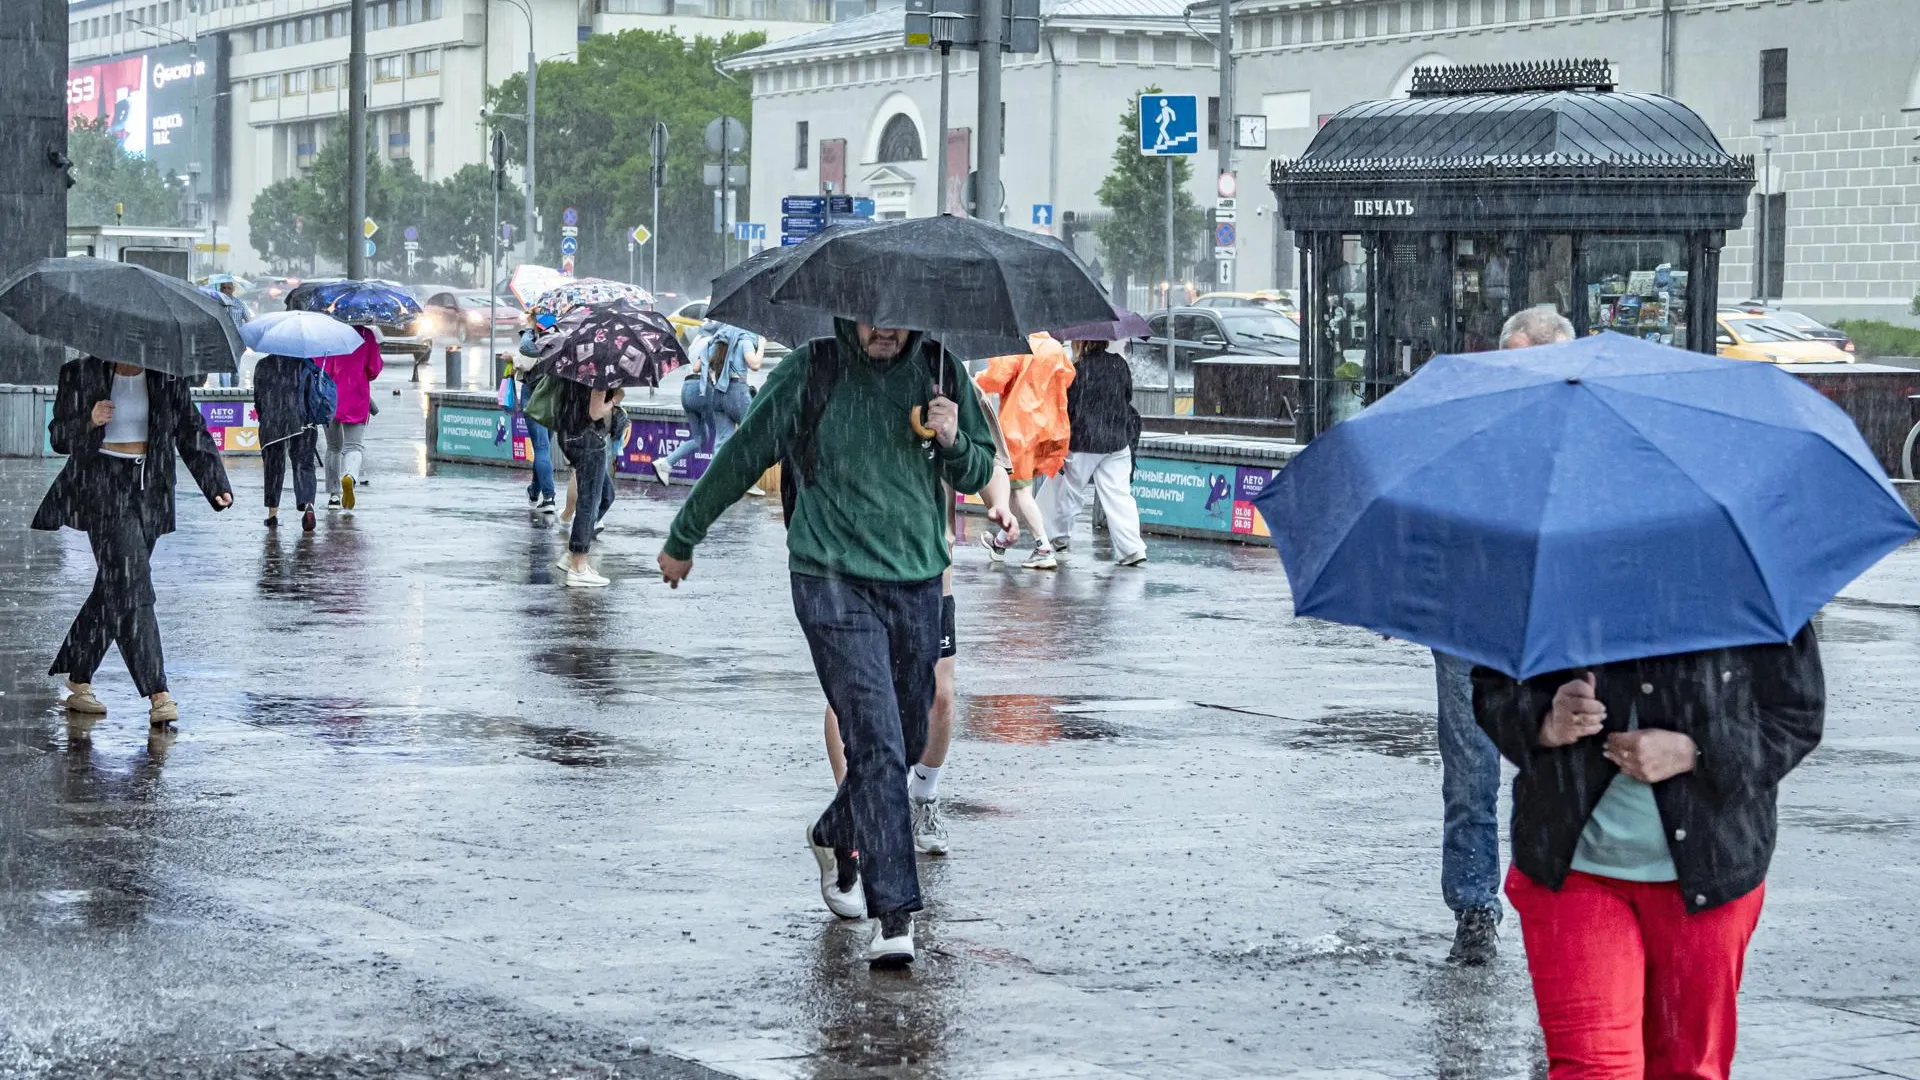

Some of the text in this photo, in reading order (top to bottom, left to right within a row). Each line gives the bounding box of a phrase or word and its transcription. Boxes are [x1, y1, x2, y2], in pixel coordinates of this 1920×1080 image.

[1354, 200, 1415, 216] ПЕЧАТЬ
[1133, 469, 1205, 488] ИЧНЫЕ АРТИСТЫ
[1243, 475, 1264, 486] ЛЕТО
